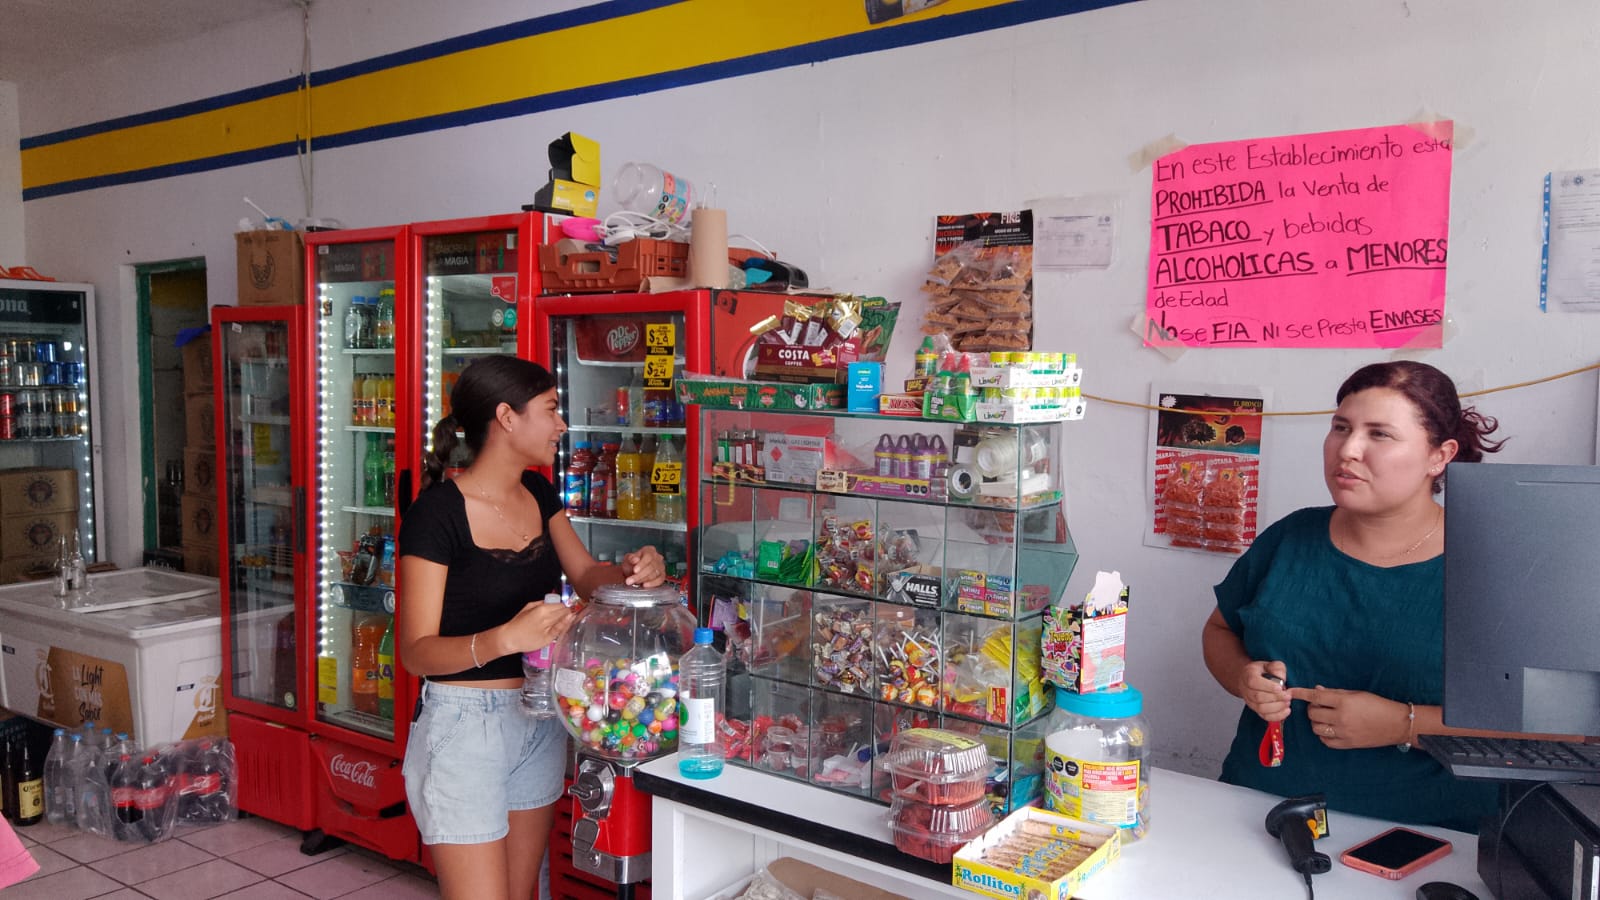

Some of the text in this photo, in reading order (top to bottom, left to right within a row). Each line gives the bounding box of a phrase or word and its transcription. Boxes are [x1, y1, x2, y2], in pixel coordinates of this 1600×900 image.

[1157, 134, 1451, 182] En este Establecimiento esta
[1155, 181, 1266, 216] PROHIBIDA
[1279, 181, 1296, 198] la
[1367, 174, 1389, 192] de
[1156, 211, 1373, 251] TABACO y bebidas
[444, 256, 469, 266] MAGIA
[1156, 238, 1447, 285] ALCOHOLICAS a MENORES
[1148, 310, 1178, 341] No
[1212, 322, 1251, 341] FIA
[1370, 309, 1443, 329] ENVASES
[778, 349, 810, 360] COSTA
[906, 582, 937, 594] HALLS
[81, 664, 104, 693] Light
[961, 867, 1020, 895] Rollitos
